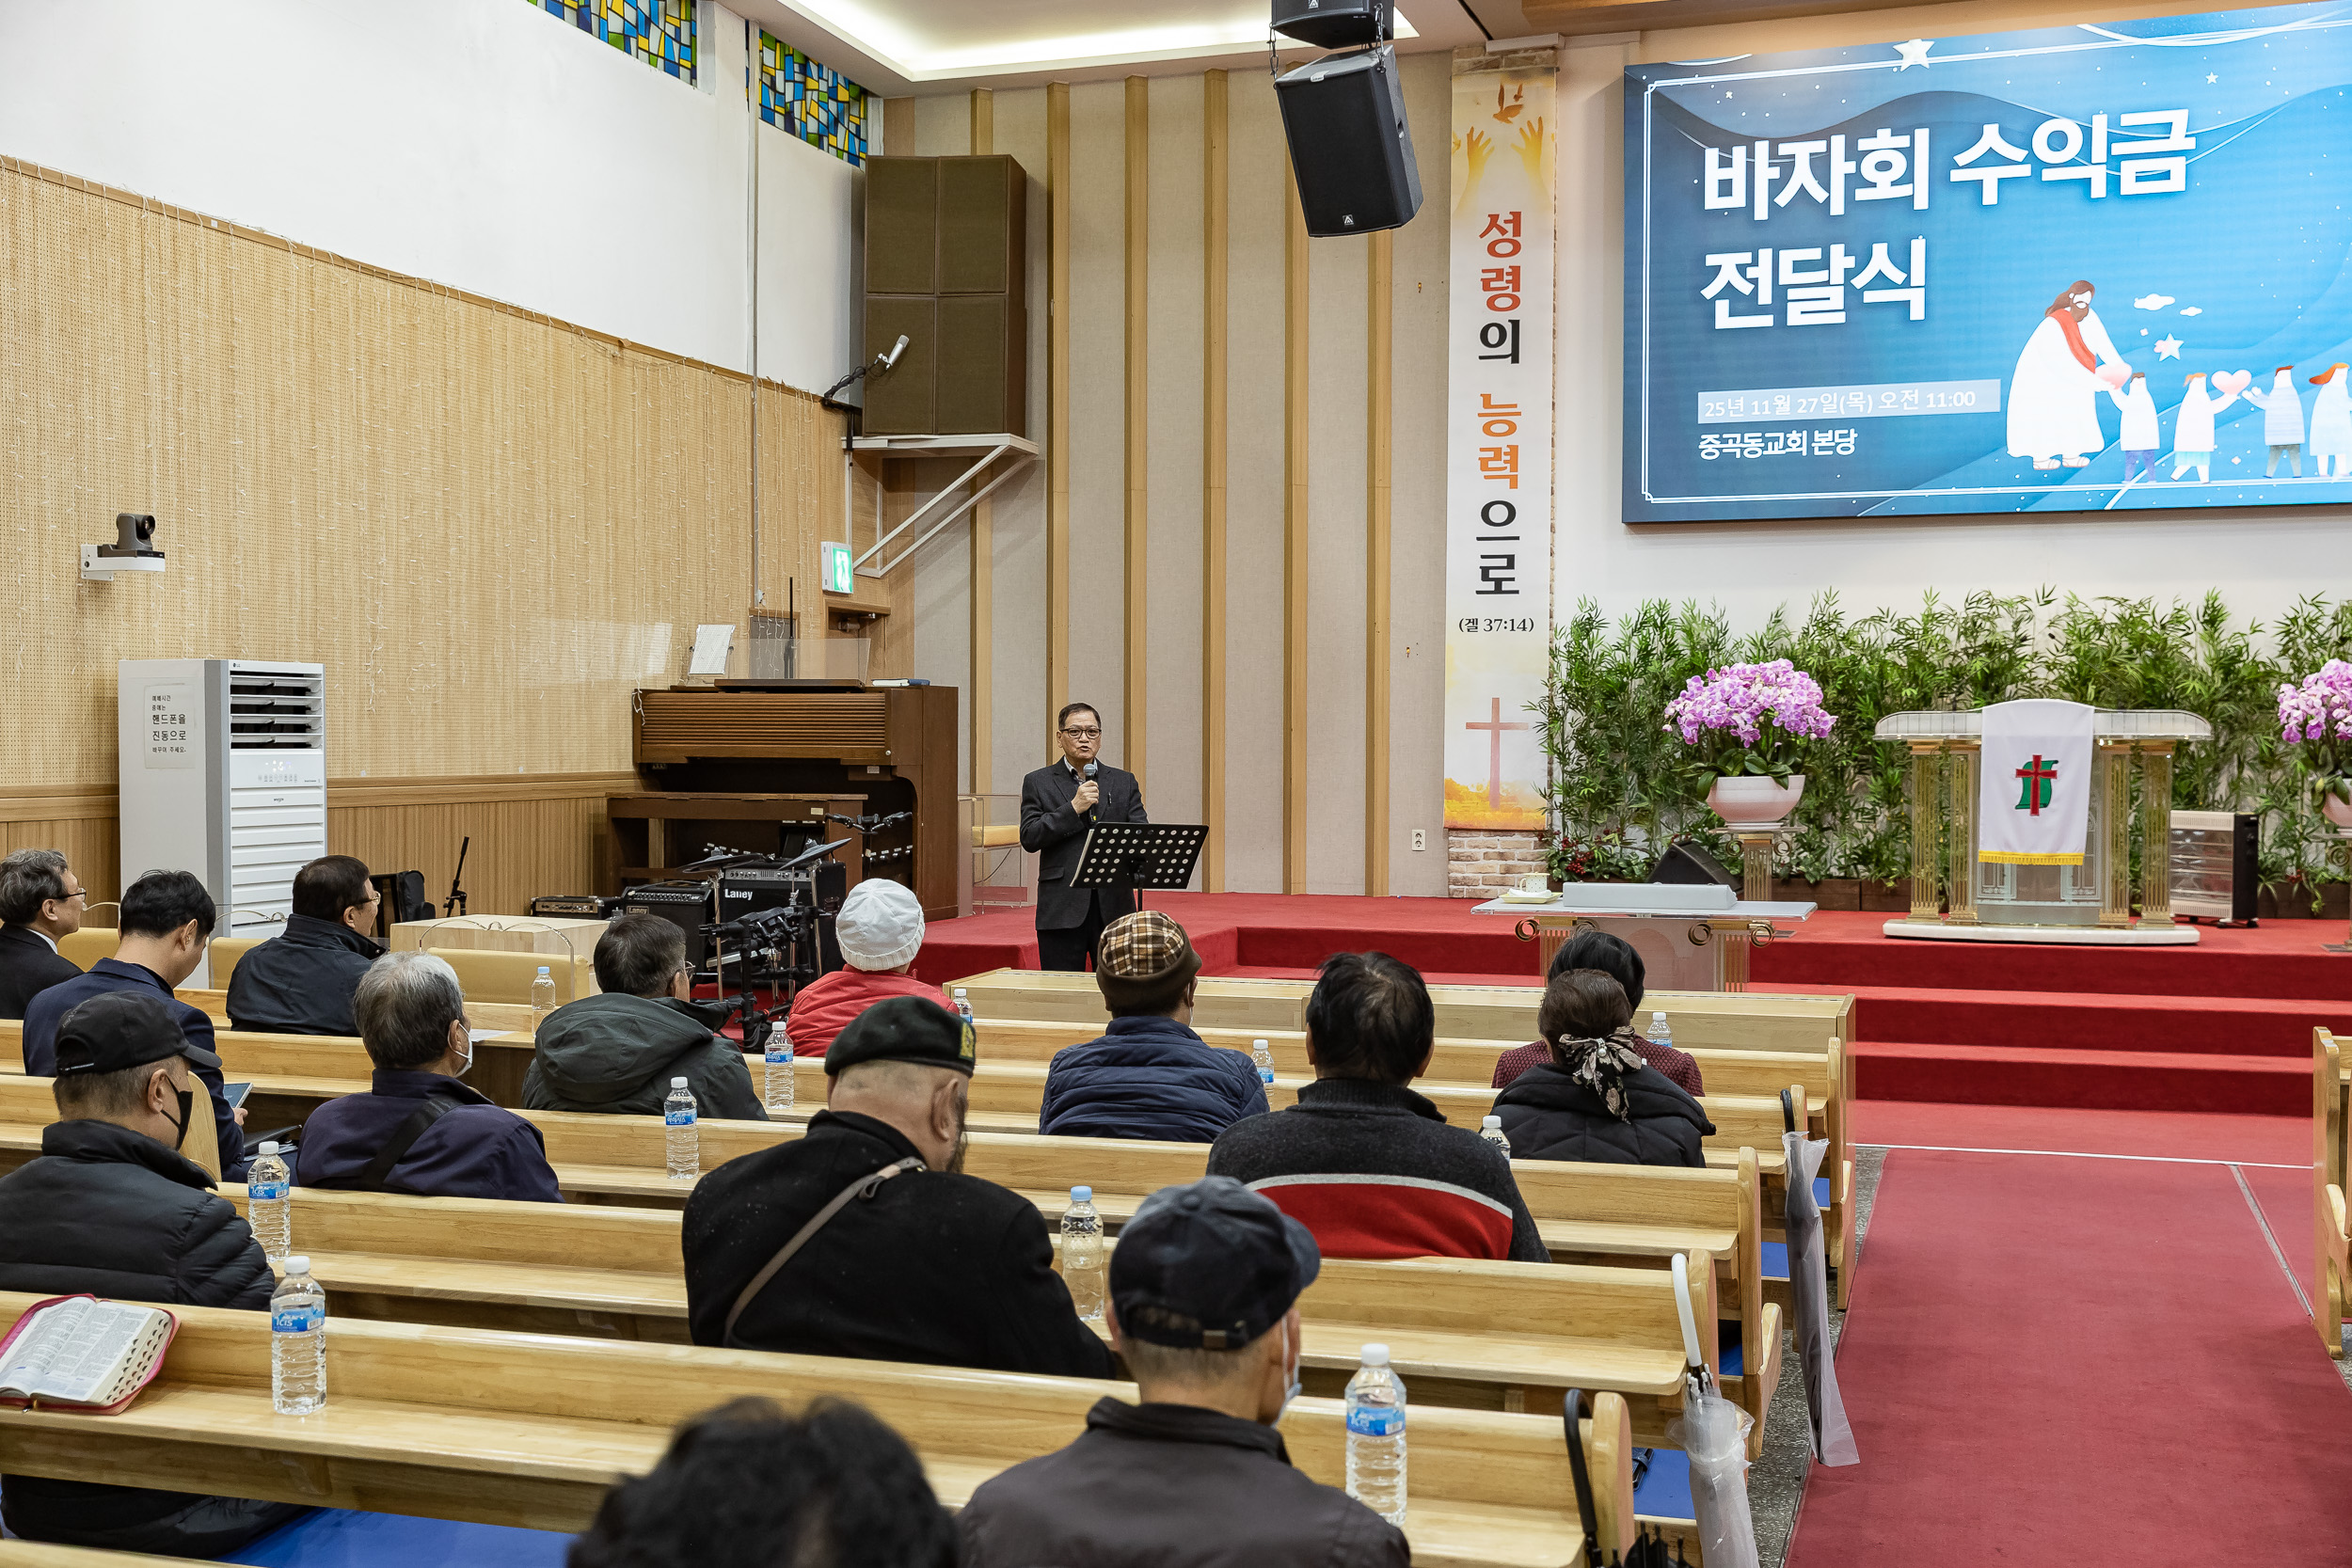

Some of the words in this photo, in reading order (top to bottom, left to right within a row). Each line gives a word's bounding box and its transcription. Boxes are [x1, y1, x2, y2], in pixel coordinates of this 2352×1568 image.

[1703, 128, 1930, 221] 바자회
[1949, 109, 2198, 206] 수익금
[1478, 211, 1523, 365] 성령의
[1699, 235, 1927, 330] 전달식
[1704, 396, 1744, 418] 25년
[1750, 394, 1791, 416] 11월
[1797, 390, 1874, 415] 27일(목)
[1878, 388, 1919, 410] 오전
[1926, 390, 1977, 409] 11:00
[1698, 430, 1808, 460] 중곡동교회
[1811, 428, 1859, 456] 본당
[1475, 393, 1523, 595] 능력으로
[1458, 617, 1479, 633] (겔
[1483, 617, 1534, 633] 37:14)
[152, 730, 186, 741] 진동으로
[724, 888, 753, 901] Laney
